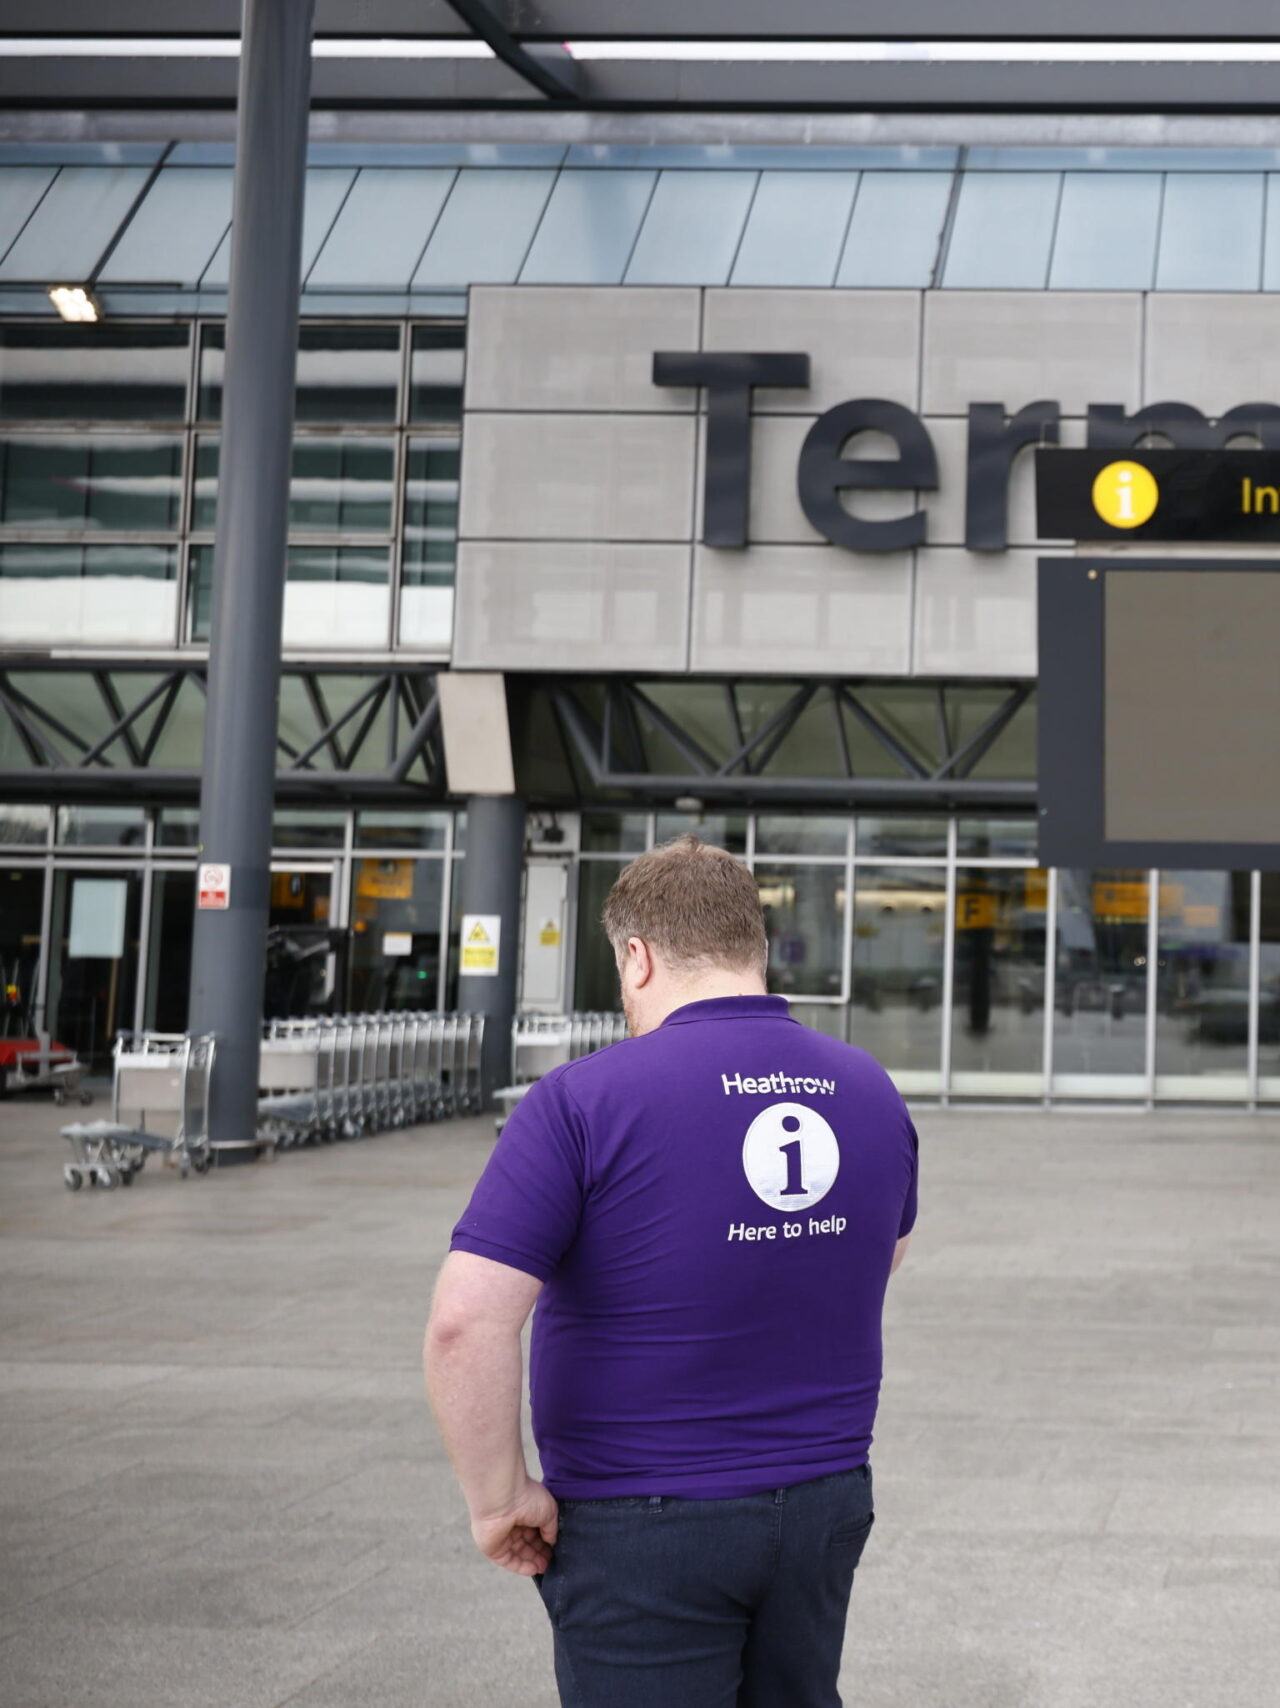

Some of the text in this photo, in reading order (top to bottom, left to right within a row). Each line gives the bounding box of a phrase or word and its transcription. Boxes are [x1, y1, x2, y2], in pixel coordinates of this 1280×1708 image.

[721, 1071, 835, 1095] Heathrow
[727, 1215, 847, 1241] Here to help
